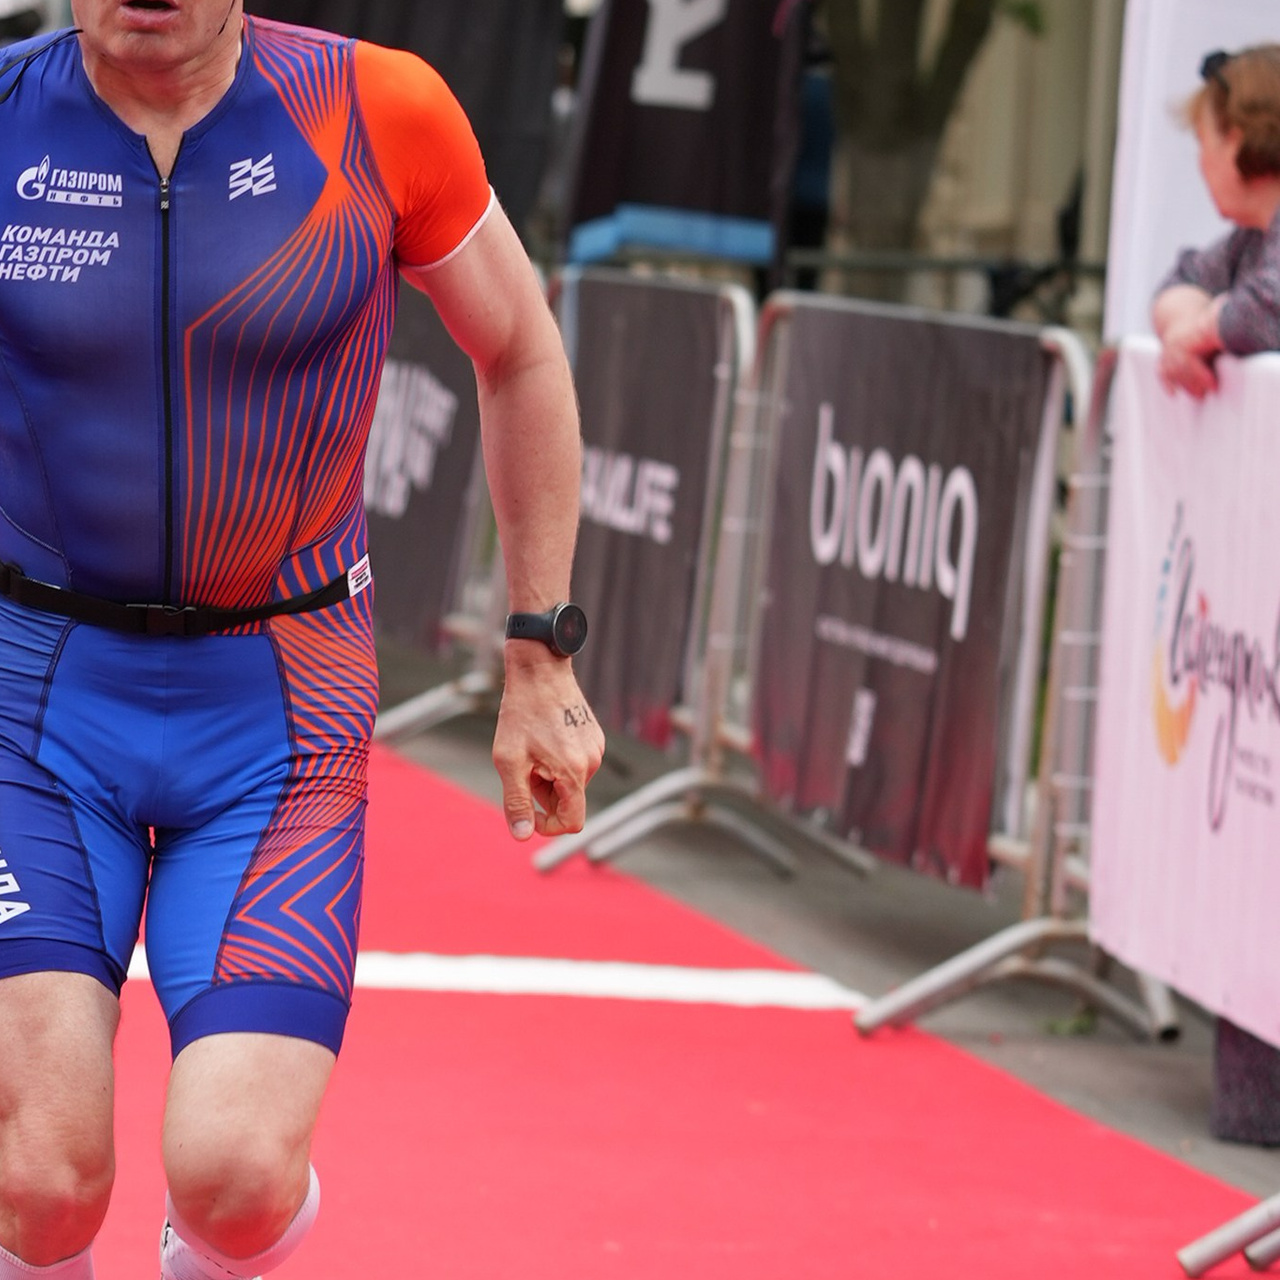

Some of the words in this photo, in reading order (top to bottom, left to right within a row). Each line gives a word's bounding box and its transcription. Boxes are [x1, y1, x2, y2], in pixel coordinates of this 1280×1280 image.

[49, 169, 123, 192] ГАЗПРОМ
[49, 192, 120, 205] НЕФТЬ
[1, 224, 120, 248] КОМАНДА
[810, 401, 978, 641] bioniq
